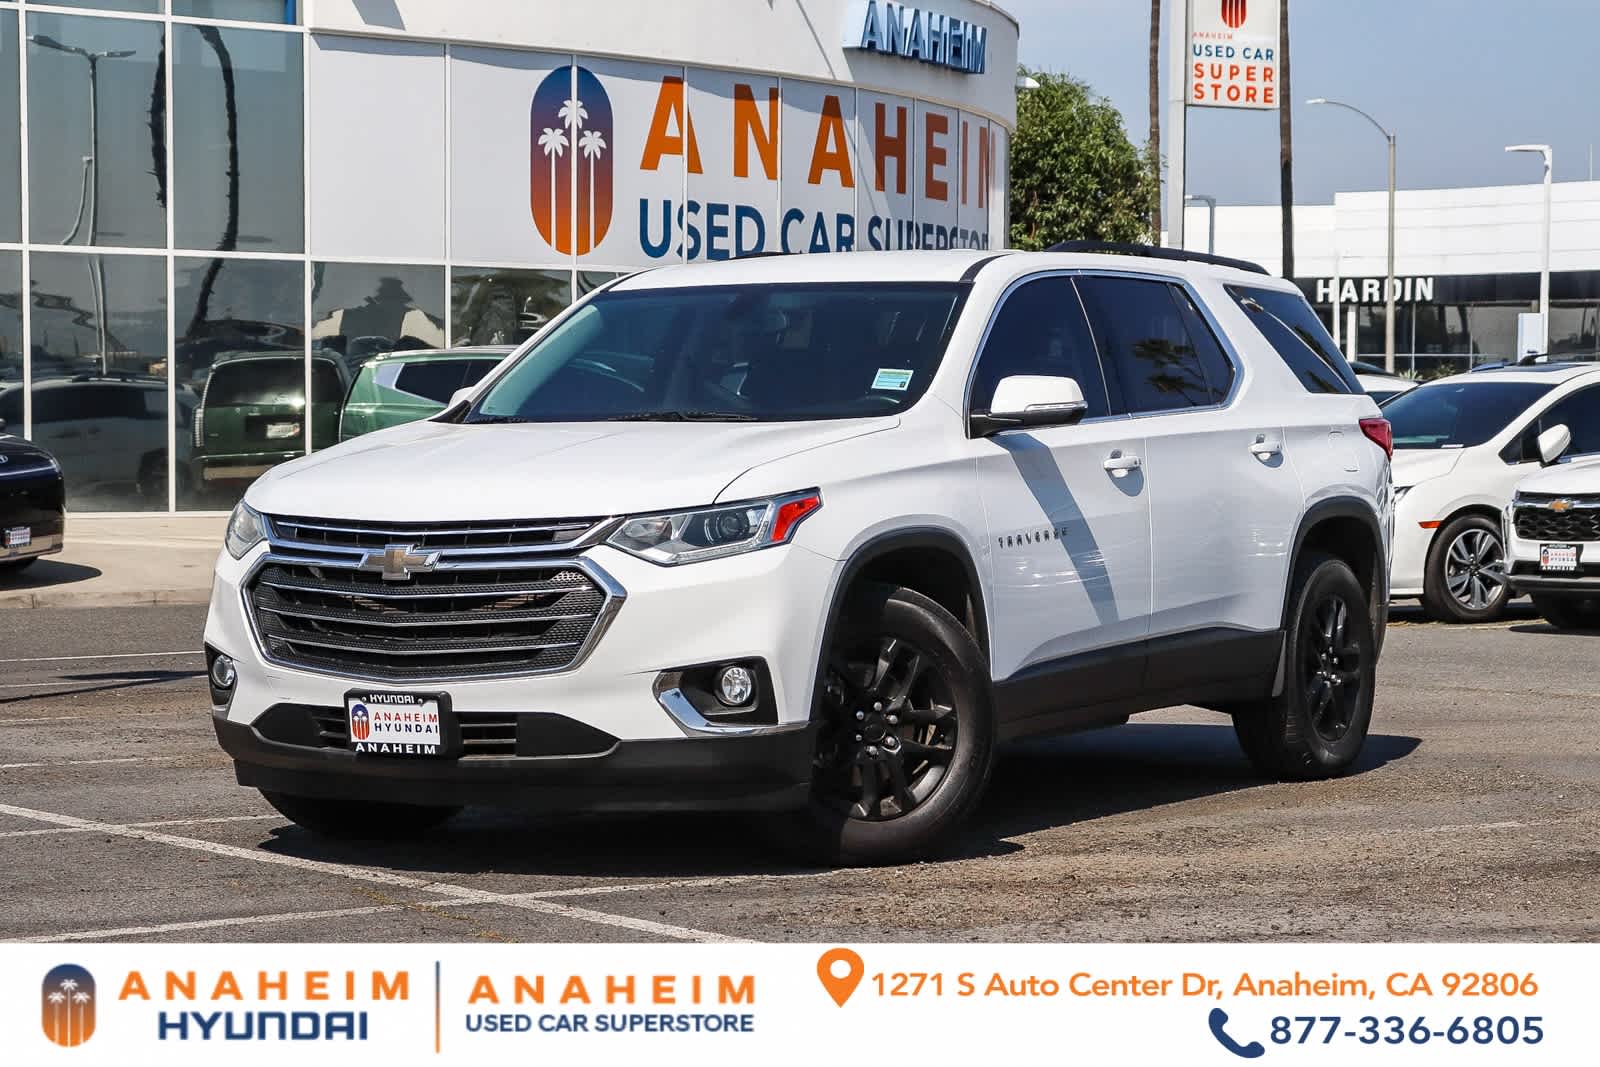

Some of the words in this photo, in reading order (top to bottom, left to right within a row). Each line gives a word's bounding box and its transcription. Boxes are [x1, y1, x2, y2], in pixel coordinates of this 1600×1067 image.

[860, 0, 988, 74] ANAHEIM
[1193, 43, 1236, 58] USED
[1243, 47, 1275, 60] CAR
[1194, 63, 1275, 82] SUPER
[1194, 83, 1275, 104] STORE
[640, 76, 997, 208] ANAHEIM
[639, 198, 766, 261] USED
[781, 207, 855, 253] CAR
[1316, 277, 1434, 303] HARDIN
[369, 694, 415, 704] HYUNDAI
[374, 712, 438, 723] ANAHEIM
[374, 723, 439, 733] HYUNDAI
[355, 743, 436, 754] ANAHEIM
